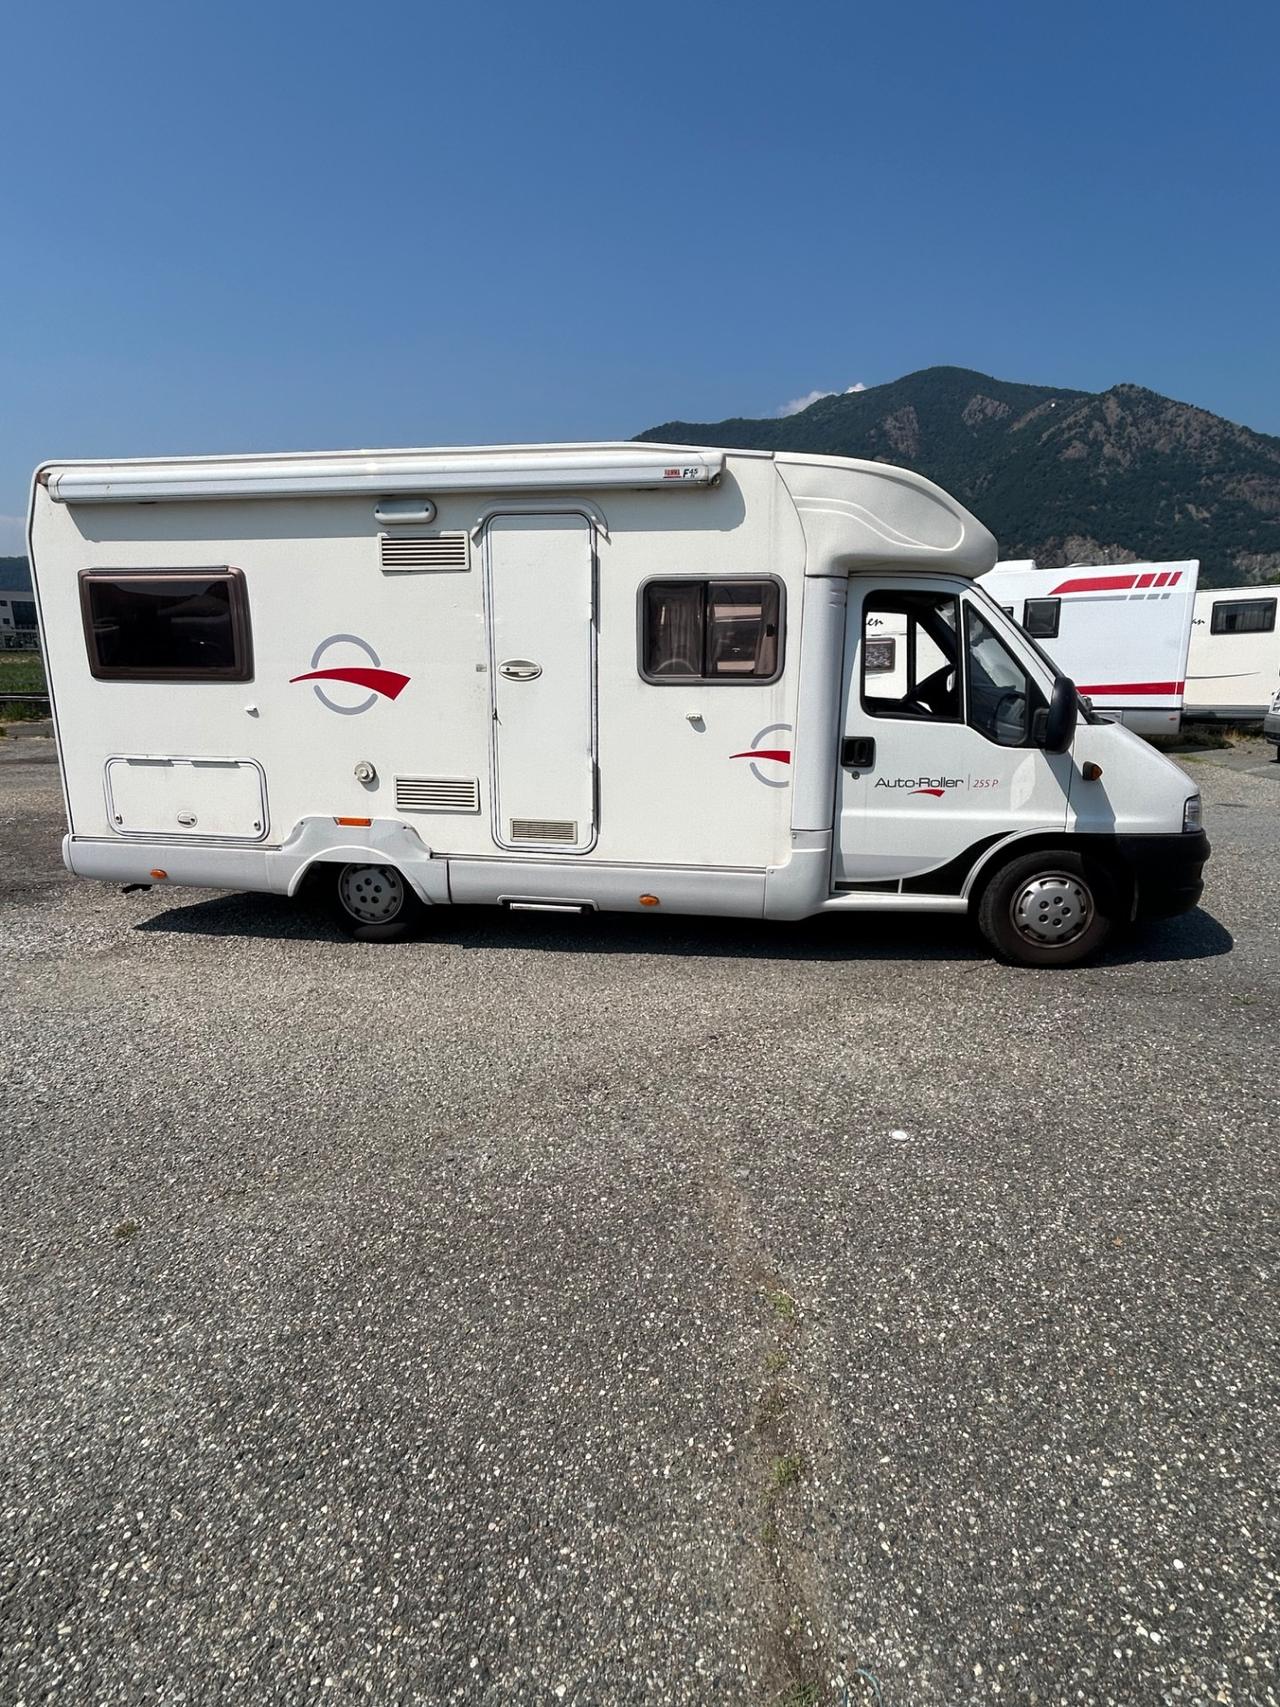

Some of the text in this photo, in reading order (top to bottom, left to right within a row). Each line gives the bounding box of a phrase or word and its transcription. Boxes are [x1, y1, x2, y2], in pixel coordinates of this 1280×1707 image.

[874, 777, 999, 788] Auto-Roller 255 P
